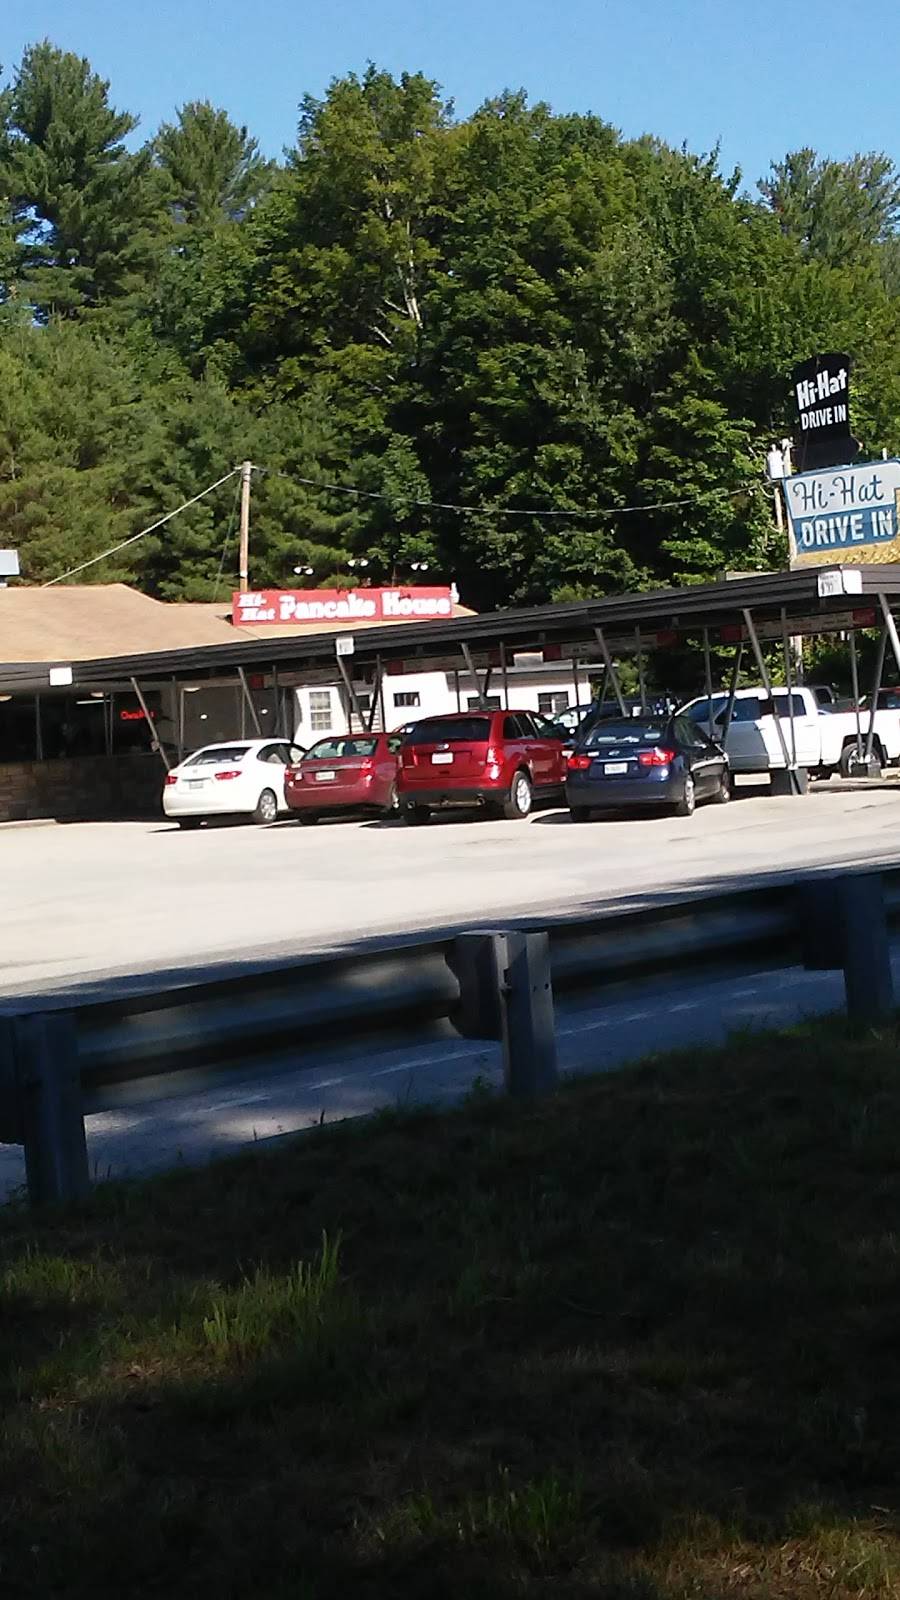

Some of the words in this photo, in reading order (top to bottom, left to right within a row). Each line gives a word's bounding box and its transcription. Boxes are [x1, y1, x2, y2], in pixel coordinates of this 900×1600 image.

[796, 368, 847, 410] Hi-Hat
[801, 407, 833, 430] DRIVE
[833, 404, 846, 423] IN
[792, 474, 884, 511] Hi-Hat
[801, 513, 864, 547] DRIVE
[871, 509, 893, 537] IN
[279, 593, 376, 620] Pancake
[381, 591, 450, 616] House
